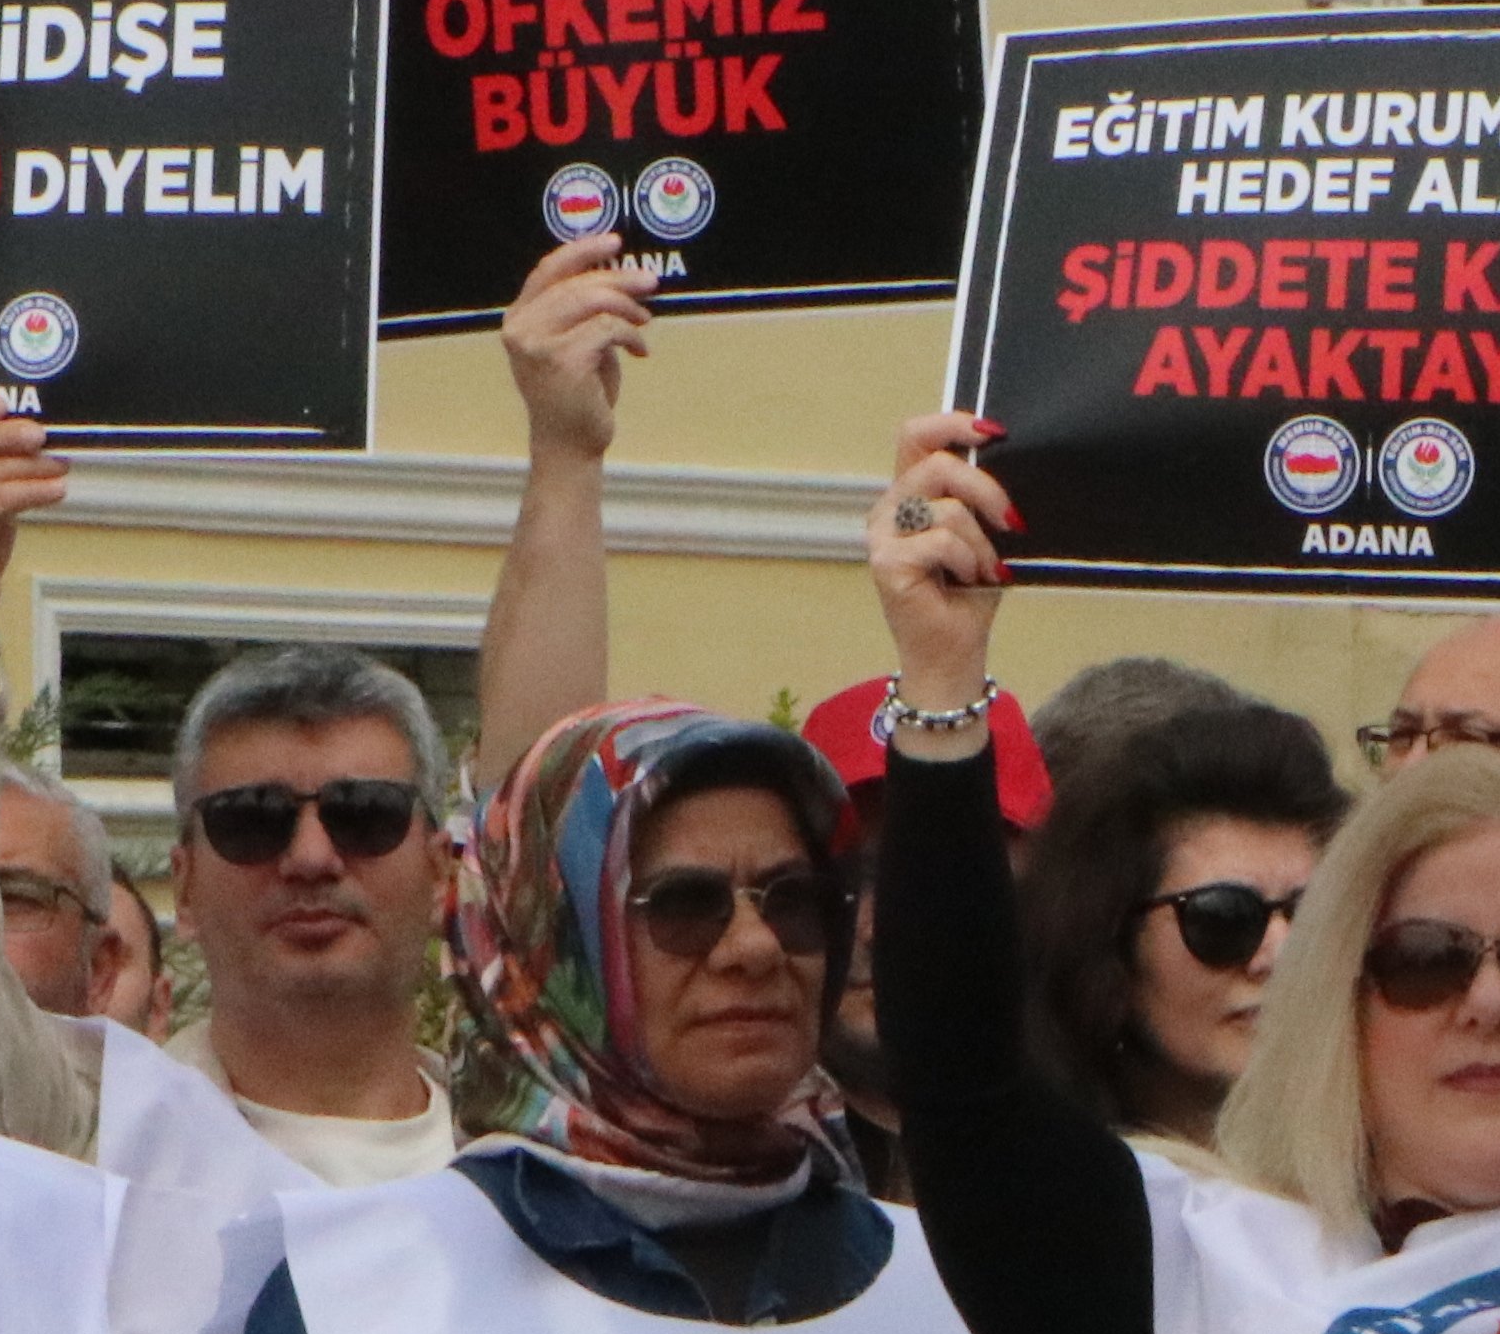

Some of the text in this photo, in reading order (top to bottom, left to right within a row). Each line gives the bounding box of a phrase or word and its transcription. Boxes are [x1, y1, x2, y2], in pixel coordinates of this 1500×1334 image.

[472, 48, 786, 152] BÜYÜK
[1052, 91, 1262, 160] EĞİTİM
[13, 145, 324, 217] DİYELİM
[1176, 160, 1393, 216] HEDEF
[1057, 240, 1419, 323] ŞİDDETE
[1301, 523, 1436, 557] ADANA
